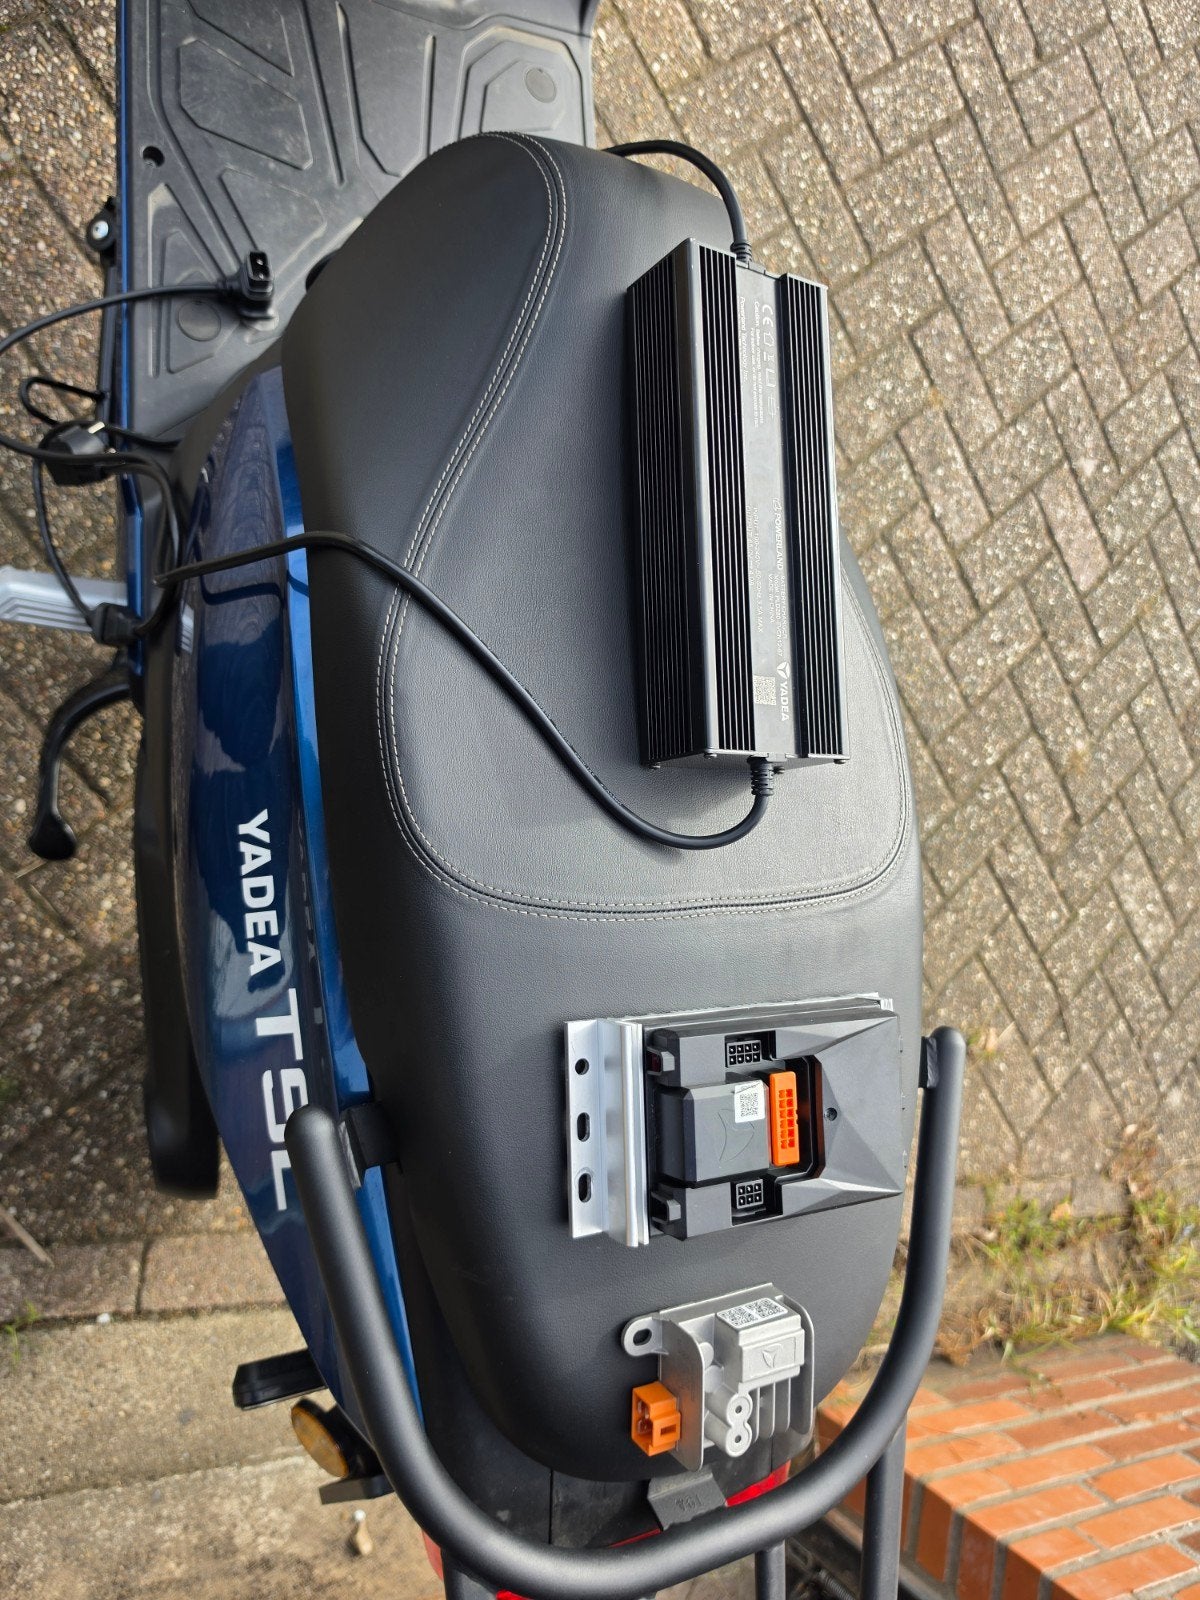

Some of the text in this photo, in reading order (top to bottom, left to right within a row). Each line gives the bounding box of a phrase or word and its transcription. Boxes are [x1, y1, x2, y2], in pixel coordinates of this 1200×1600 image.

[774, 512, 784, 571] POWERLAND
[779, 680, 790, 722] YADEA
[237, 808, 282, 977] YADEA
